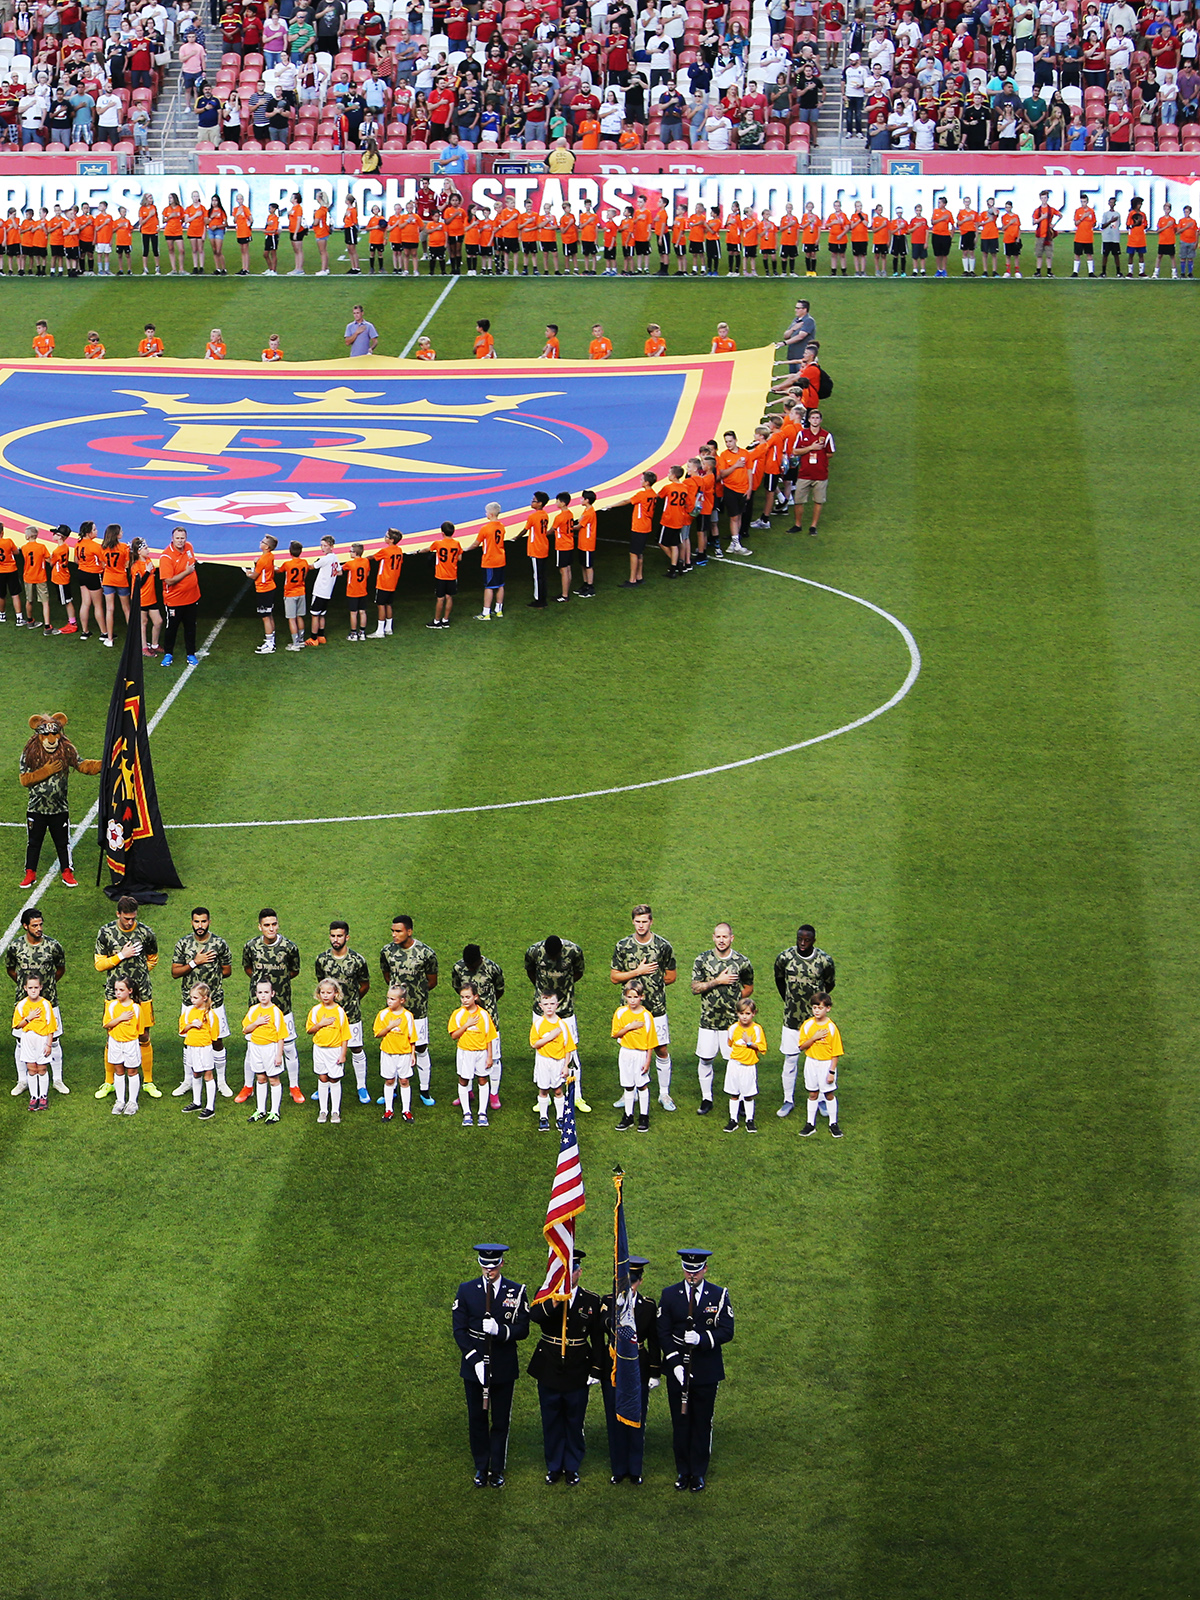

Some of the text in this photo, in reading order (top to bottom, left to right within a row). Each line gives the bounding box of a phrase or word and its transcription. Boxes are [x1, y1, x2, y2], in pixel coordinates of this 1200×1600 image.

[270, 178, 449, 229] BRIGH
[472, 178, 634, 228] STARS
[653, 178, 891, 228] THROUGH
[910, 178, 1015, 228] THE
[670, 491, 688, 507] 28
[494, 529, 502, 545] 6
[28, 551, 34, 567] 1
[105, 552, 120, 568] 17
[390, 554, 402, 570] 17
[439, 547, 459, 563] 97
[290, 567, 306, 583] 21
[356, 567, 365, 583] 9
[352, 1026, 360, 1037] 9
[419, 1025, 425, 1036] 4
[656, 1024, 667, 1037] 25
